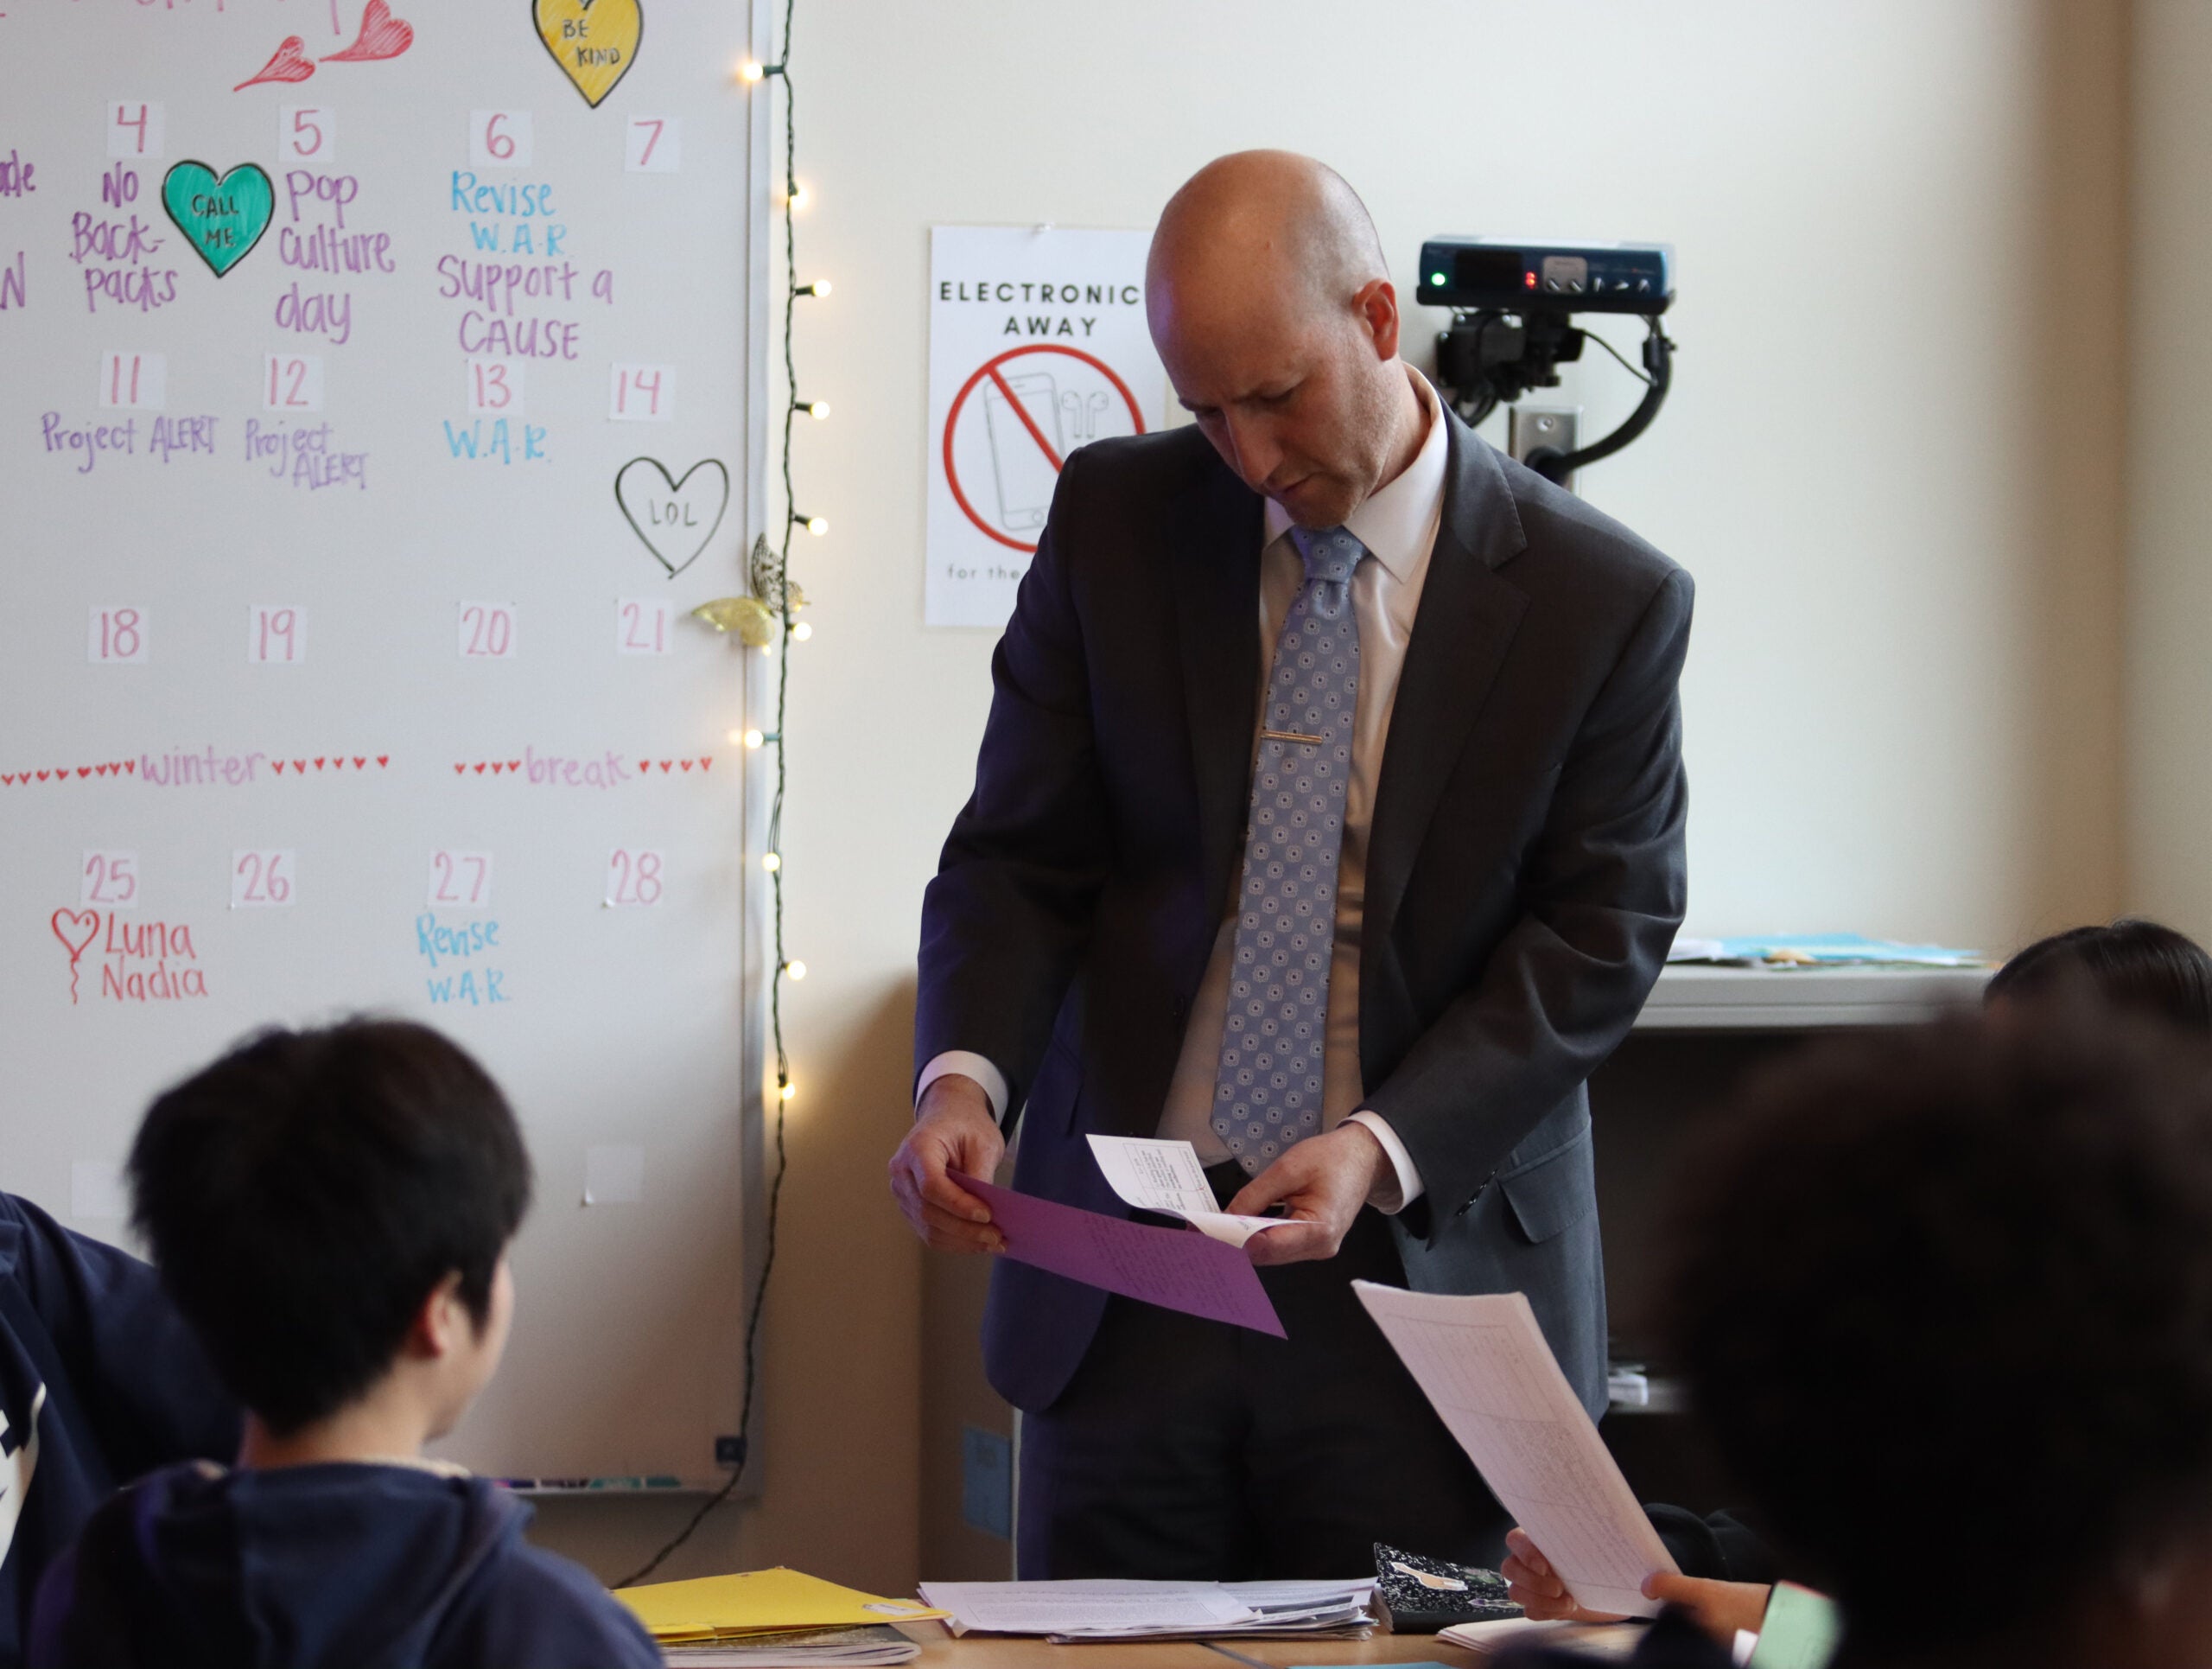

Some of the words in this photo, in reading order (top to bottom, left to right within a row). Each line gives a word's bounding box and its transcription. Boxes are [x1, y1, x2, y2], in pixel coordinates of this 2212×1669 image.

[563, 19, 588, 39] BE
[576, 47, 621, 67] KIND
[117, 104, 147, 153] 4
[293, 109, 322, 156] 5
[486, 112, 516, 160] 6
[634, 119, 664, 166] 7
[192, 194, 239, 218] CALL
[451, 170, 556, 217] Revise
[205, 227, 234, 249] ME
[85, 266, 178, 313] packs
[437, 254, 577, 316] Support
[592, 270, 613, 304] a
[276, 282, 351, 345] day
[459, 311, 579, 360] CAUSE
[1003, 315, 1097, 337] AWAY
[112, 355, 141, 405] 11
[270, 357, 308, 405] 12
[475, 364, 512, 408] 13
[618, 369, 661, 414] 14
[41, 411, 137, 474] Project
[149, 416, 219, 463] ALERT
[245, 418, 334, 477] Project
[292, 451, 369, 490] ALERT
[649, 499, 698, 527] LOL
[947, 564, 976, 580] for
[988, 565, 1020, 580] the
[101, 608, 140, 659] 18
[260, 608, 296, 660] 19
[462, 606, 511, 655] 20
[623, 602, 664, 653] 21
[142, 745, 266, 787] winter
[526, 746, 631, 790] break
[86, 854, 136, 903] 25
[238, 852, 289, 902] 26
[435, 851, 486, 902] 27
[611, 849, 663, 905] 28
[105, 912, 196, 960] Luna
[102, 955, 208, 1002] Nadia
